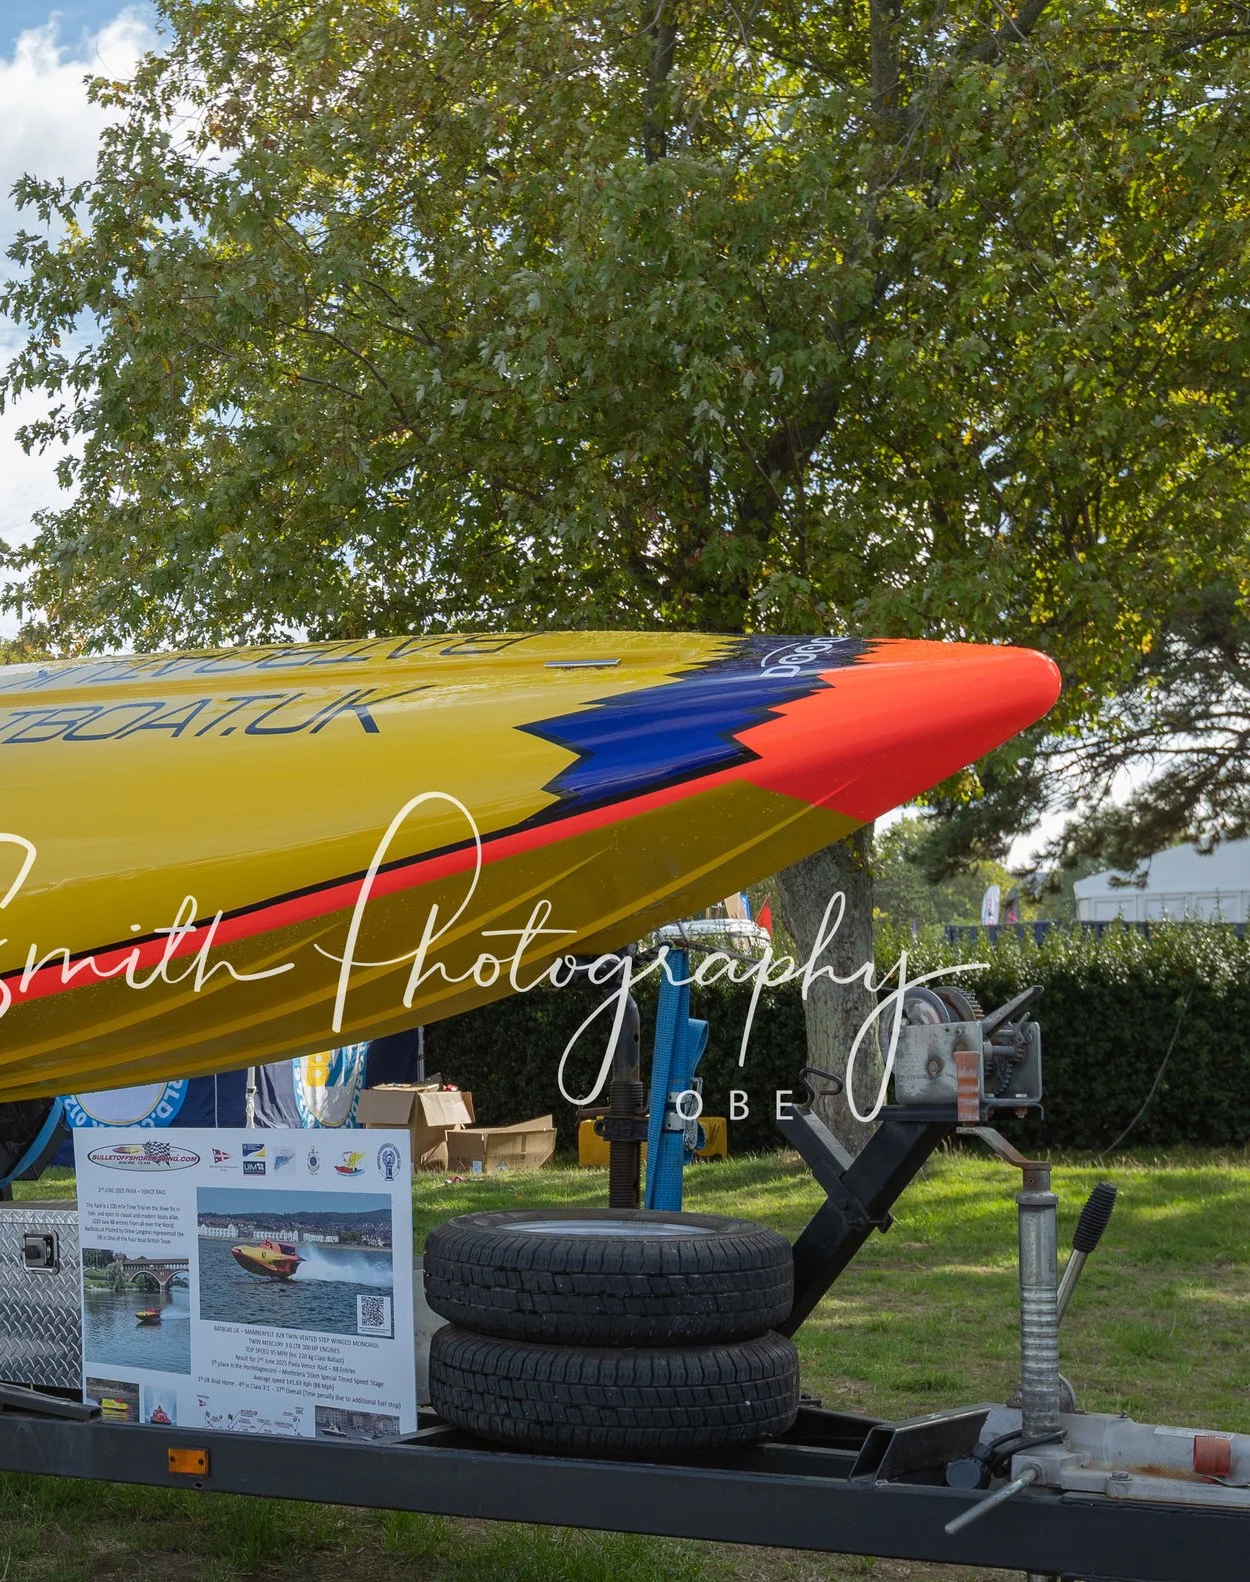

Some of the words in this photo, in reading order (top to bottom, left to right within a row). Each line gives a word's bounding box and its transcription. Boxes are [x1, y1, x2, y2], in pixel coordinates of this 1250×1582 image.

[245, 1329, 274, 1338] MANNERFELT
[299, 1334, 318, 1342] VENTED
[319, 1346, 340, 1354] ENGINES
[253, 1374, 270, 1382] Average
[272, 1377, 285, 1385] speed
[303, 1380, 312, 1388] Kph
[338, 1375, 353, 1383] Timed
[370, 1380, 384, 1388] Stage
[317, 1392, 334, 1401] penalty
[352, 1397, 377, 1405] additional
[377, 1399, 387, 1407] fuel
